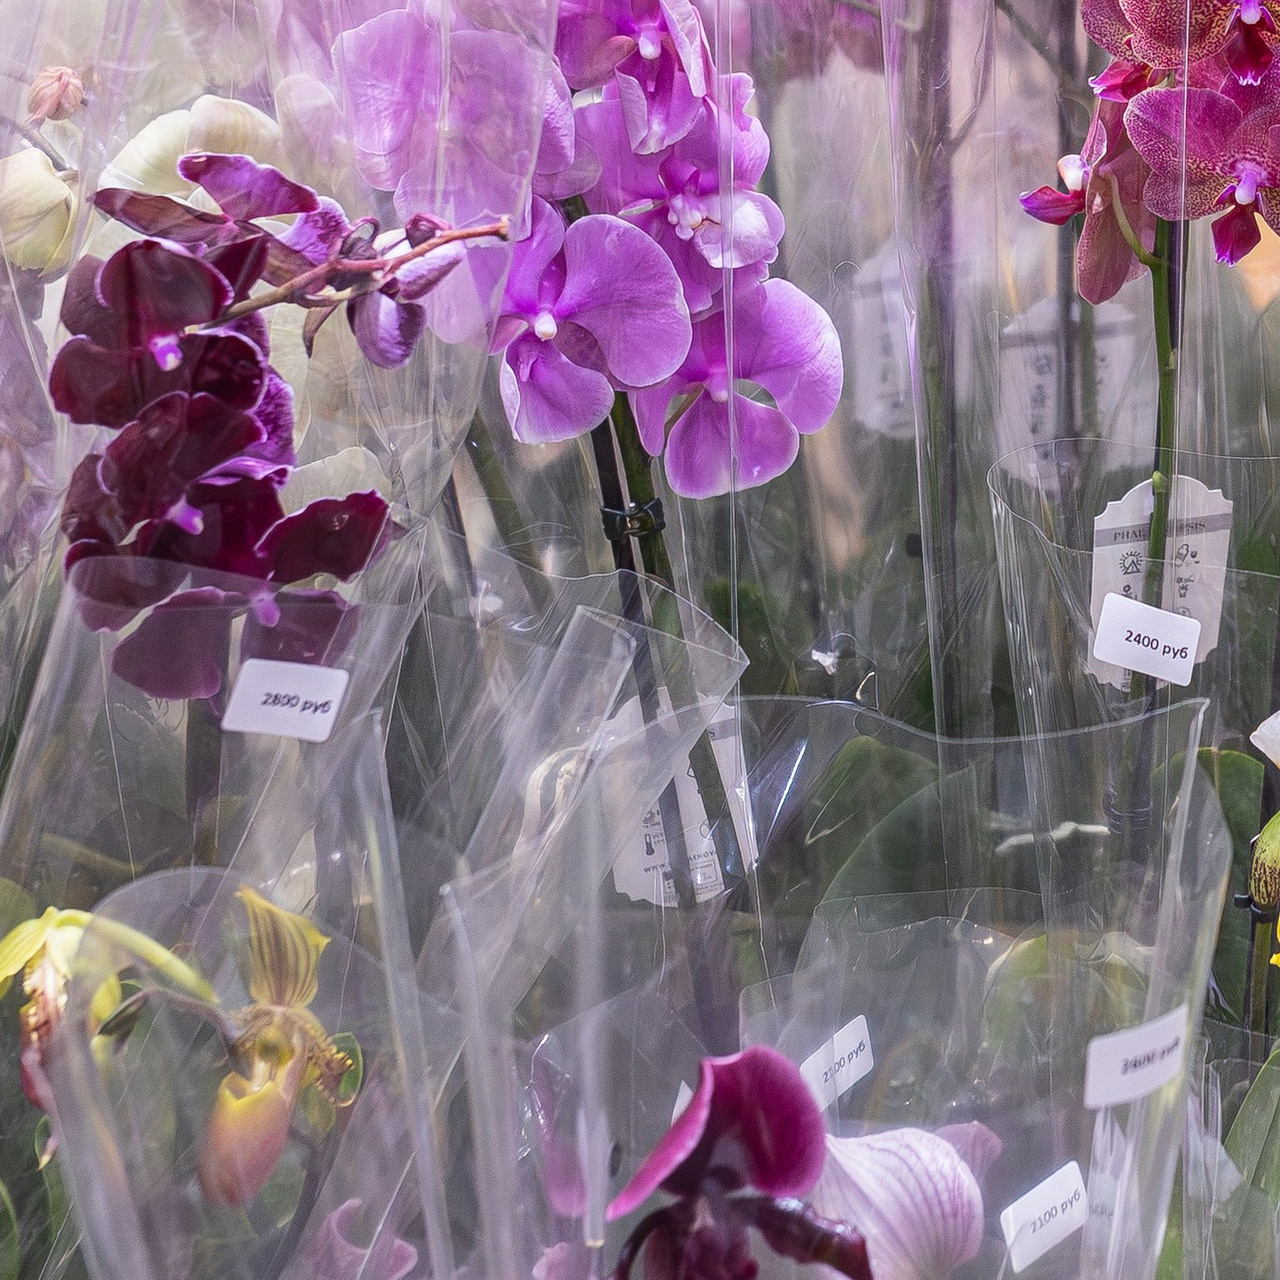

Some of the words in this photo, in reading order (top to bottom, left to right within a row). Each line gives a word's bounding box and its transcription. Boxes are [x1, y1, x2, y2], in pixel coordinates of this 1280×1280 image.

[1124, 630, 1159, 651] 2400
[1162, 641, 1189, 660] руб
[260, 692, 300, 708] 2800
[300, 697, 331, 714] руб
[847, 1039, 867, 1063] руб
[1030, 1206, 1058, 1234] 2100
[1060, 1188, 1081, 1215] руб
